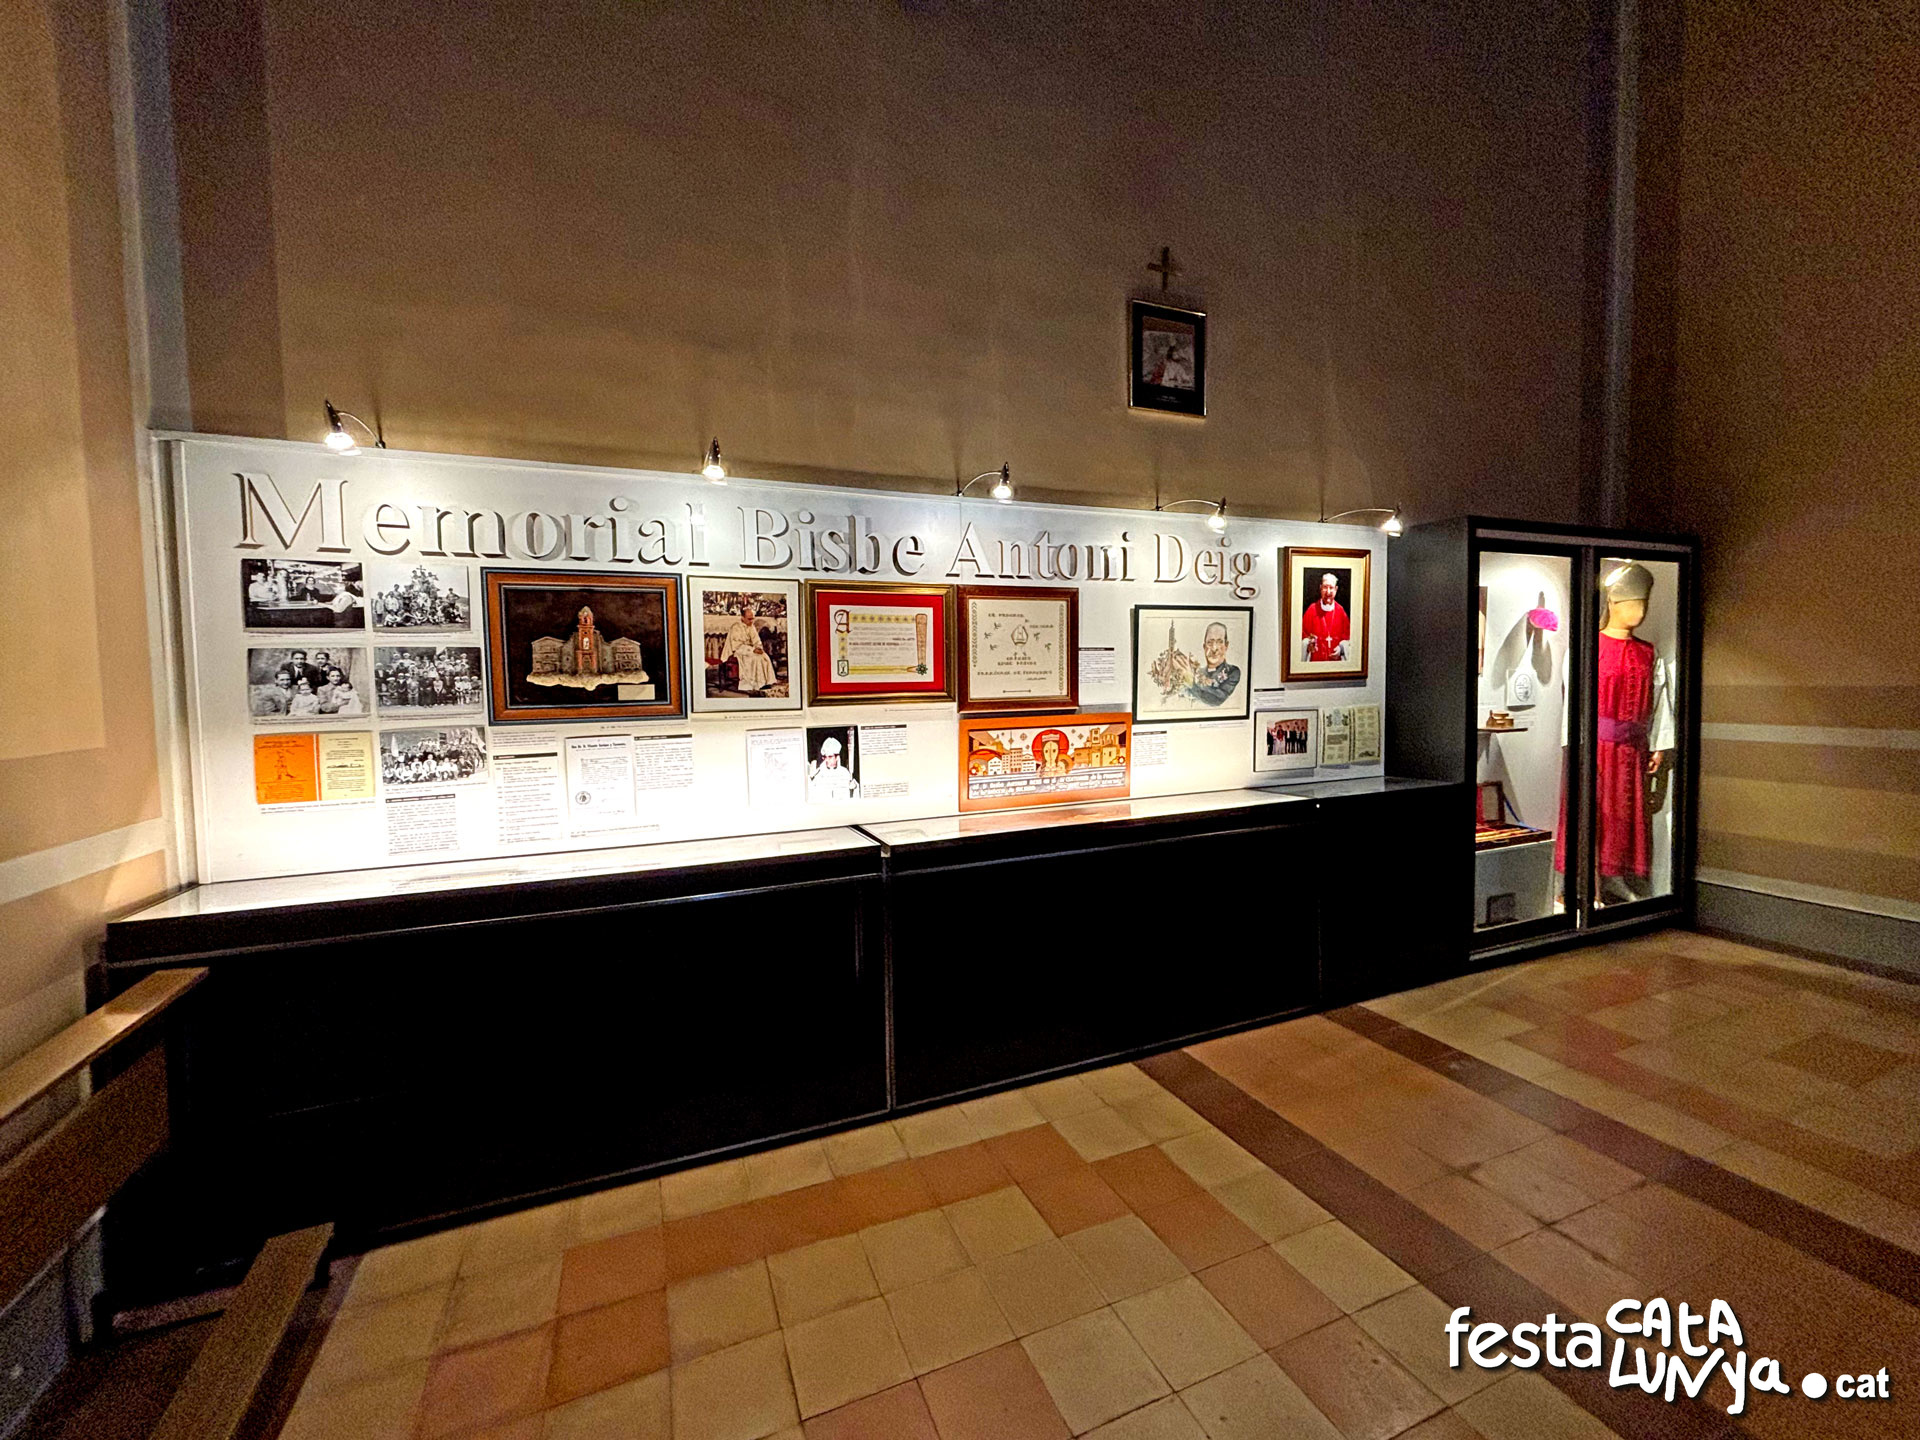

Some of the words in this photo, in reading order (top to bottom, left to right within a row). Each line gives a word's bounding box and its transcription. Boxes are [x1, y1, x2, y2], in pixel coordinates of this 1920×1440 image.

[232, 472, 710, 566] Memorial
[738, 505, 926, 575] Bisbe
[946, 521, 1135, 582] Antoni
[1153, 532, 1260, 599] Deig
